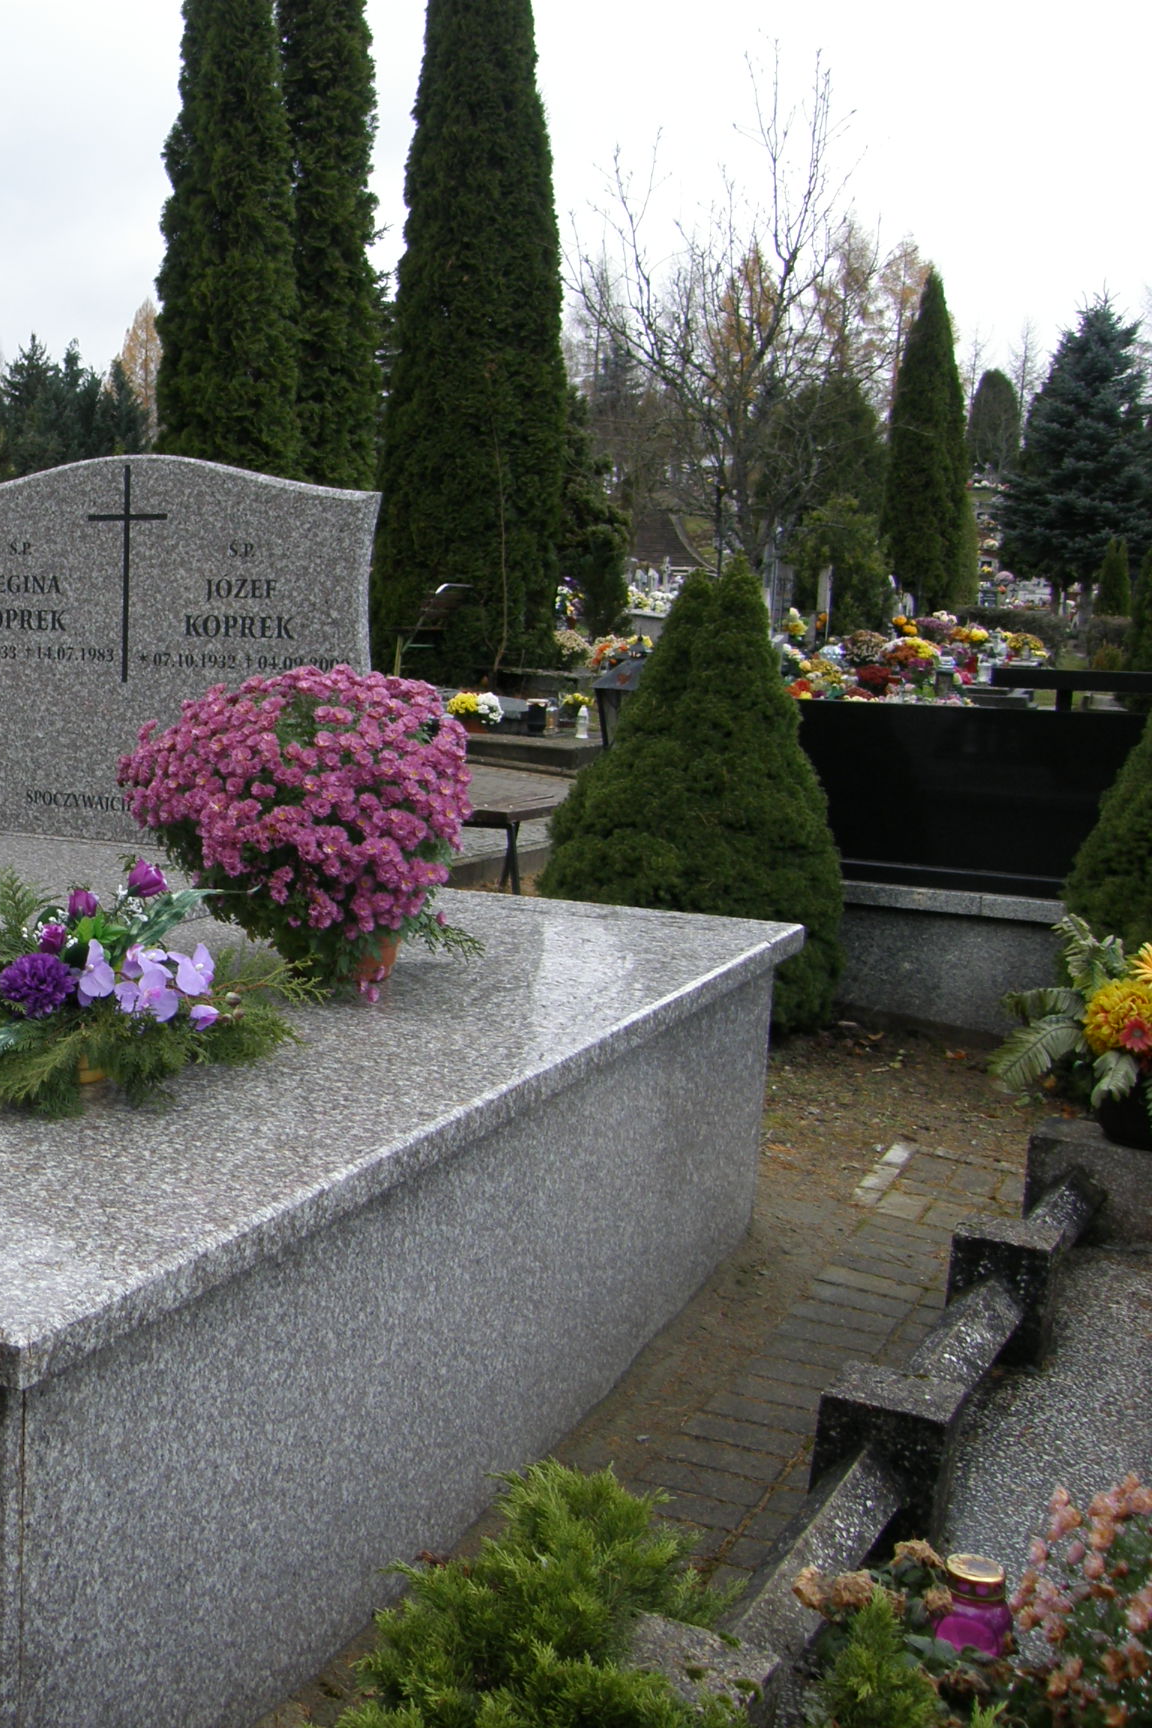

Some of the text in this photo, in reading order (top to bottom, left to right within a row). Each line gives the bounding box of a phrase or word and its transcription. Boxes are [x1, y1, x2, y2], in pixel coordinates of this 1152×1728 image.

[229, 540, 255, 558] Ś.P.
[206, 573, 278, 602] JÓZEF
[184, 614, 296, 640] KOPREK
[36, 645, 115, 663] 14.07.1983
[152, 652, 237, 669] 07.10.1932
